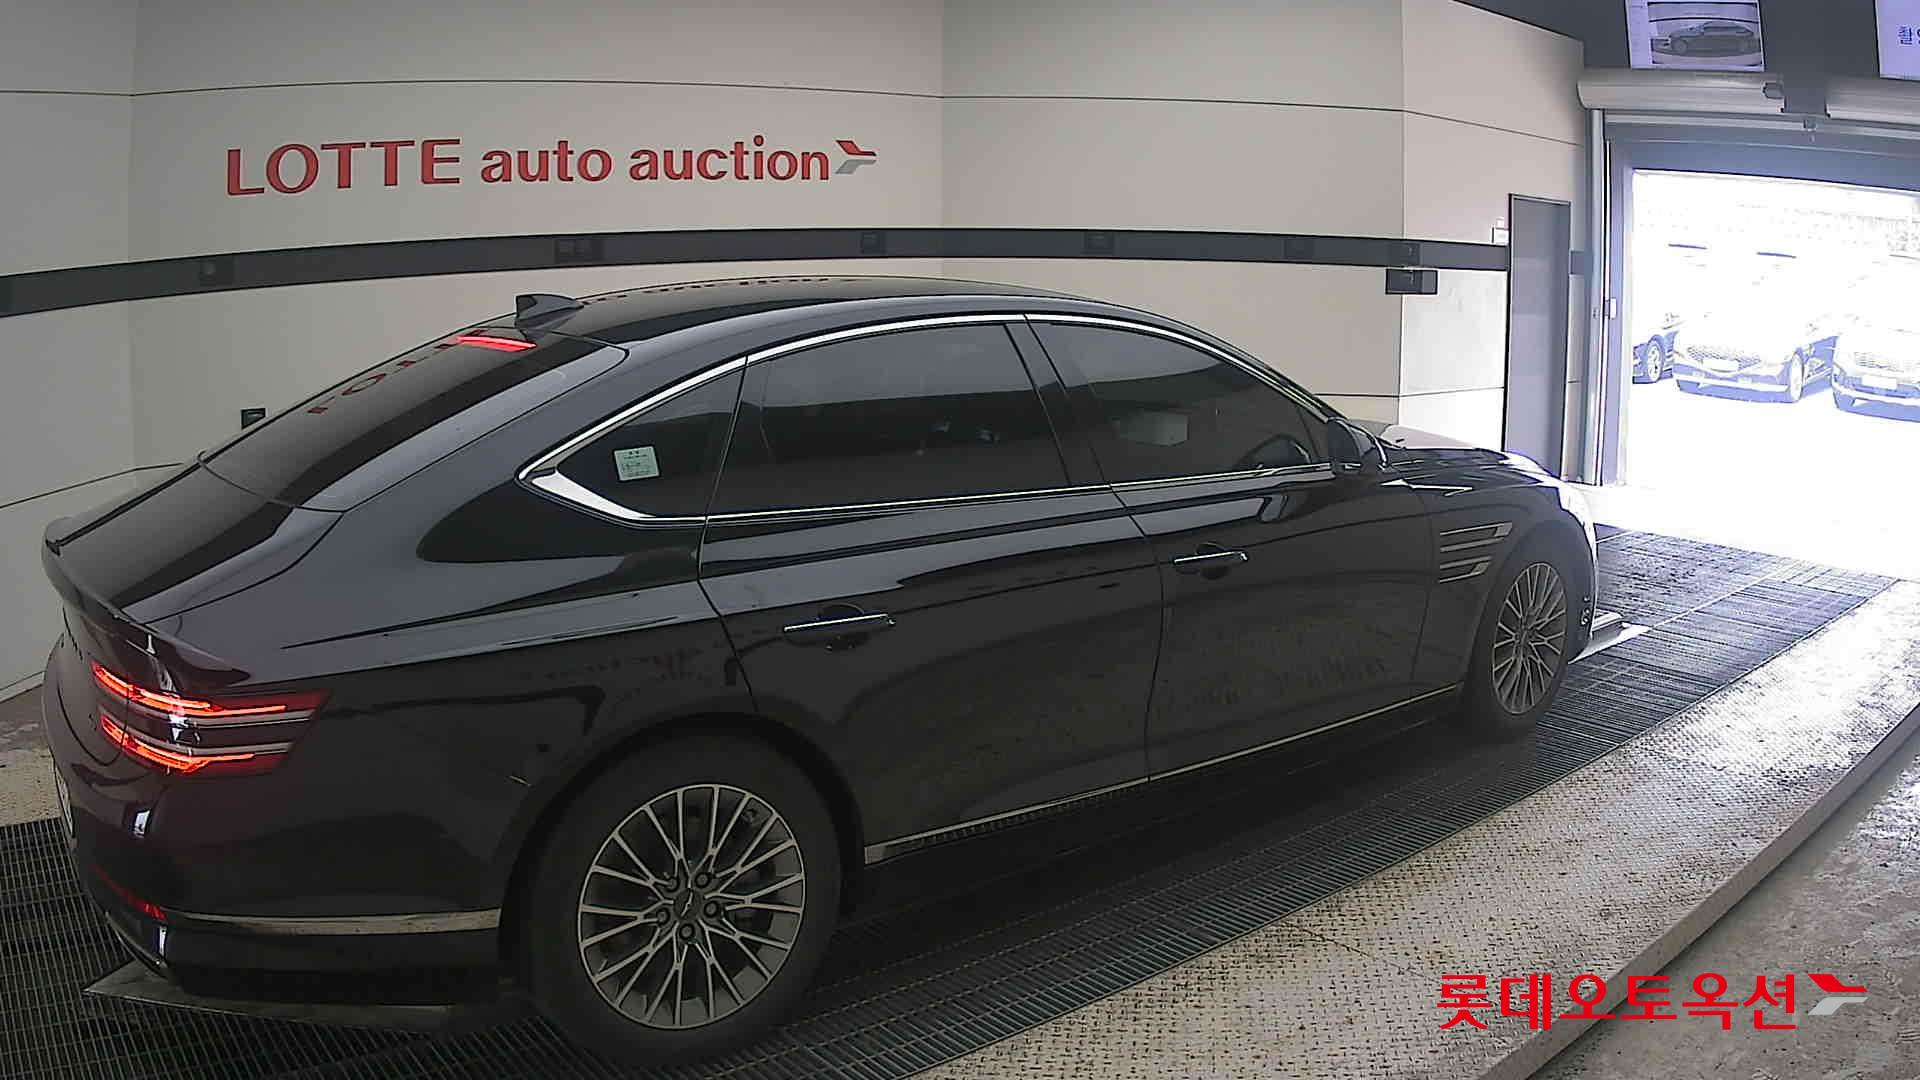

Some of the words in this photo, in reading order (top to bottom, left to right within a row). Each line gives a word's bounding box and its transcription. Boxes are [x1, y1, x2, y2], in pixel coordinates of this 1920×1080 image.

[227, 138, 459, 197] LOTTE
[480, 139, 615, 183] auto
[628, 135, 831, 183] auction
